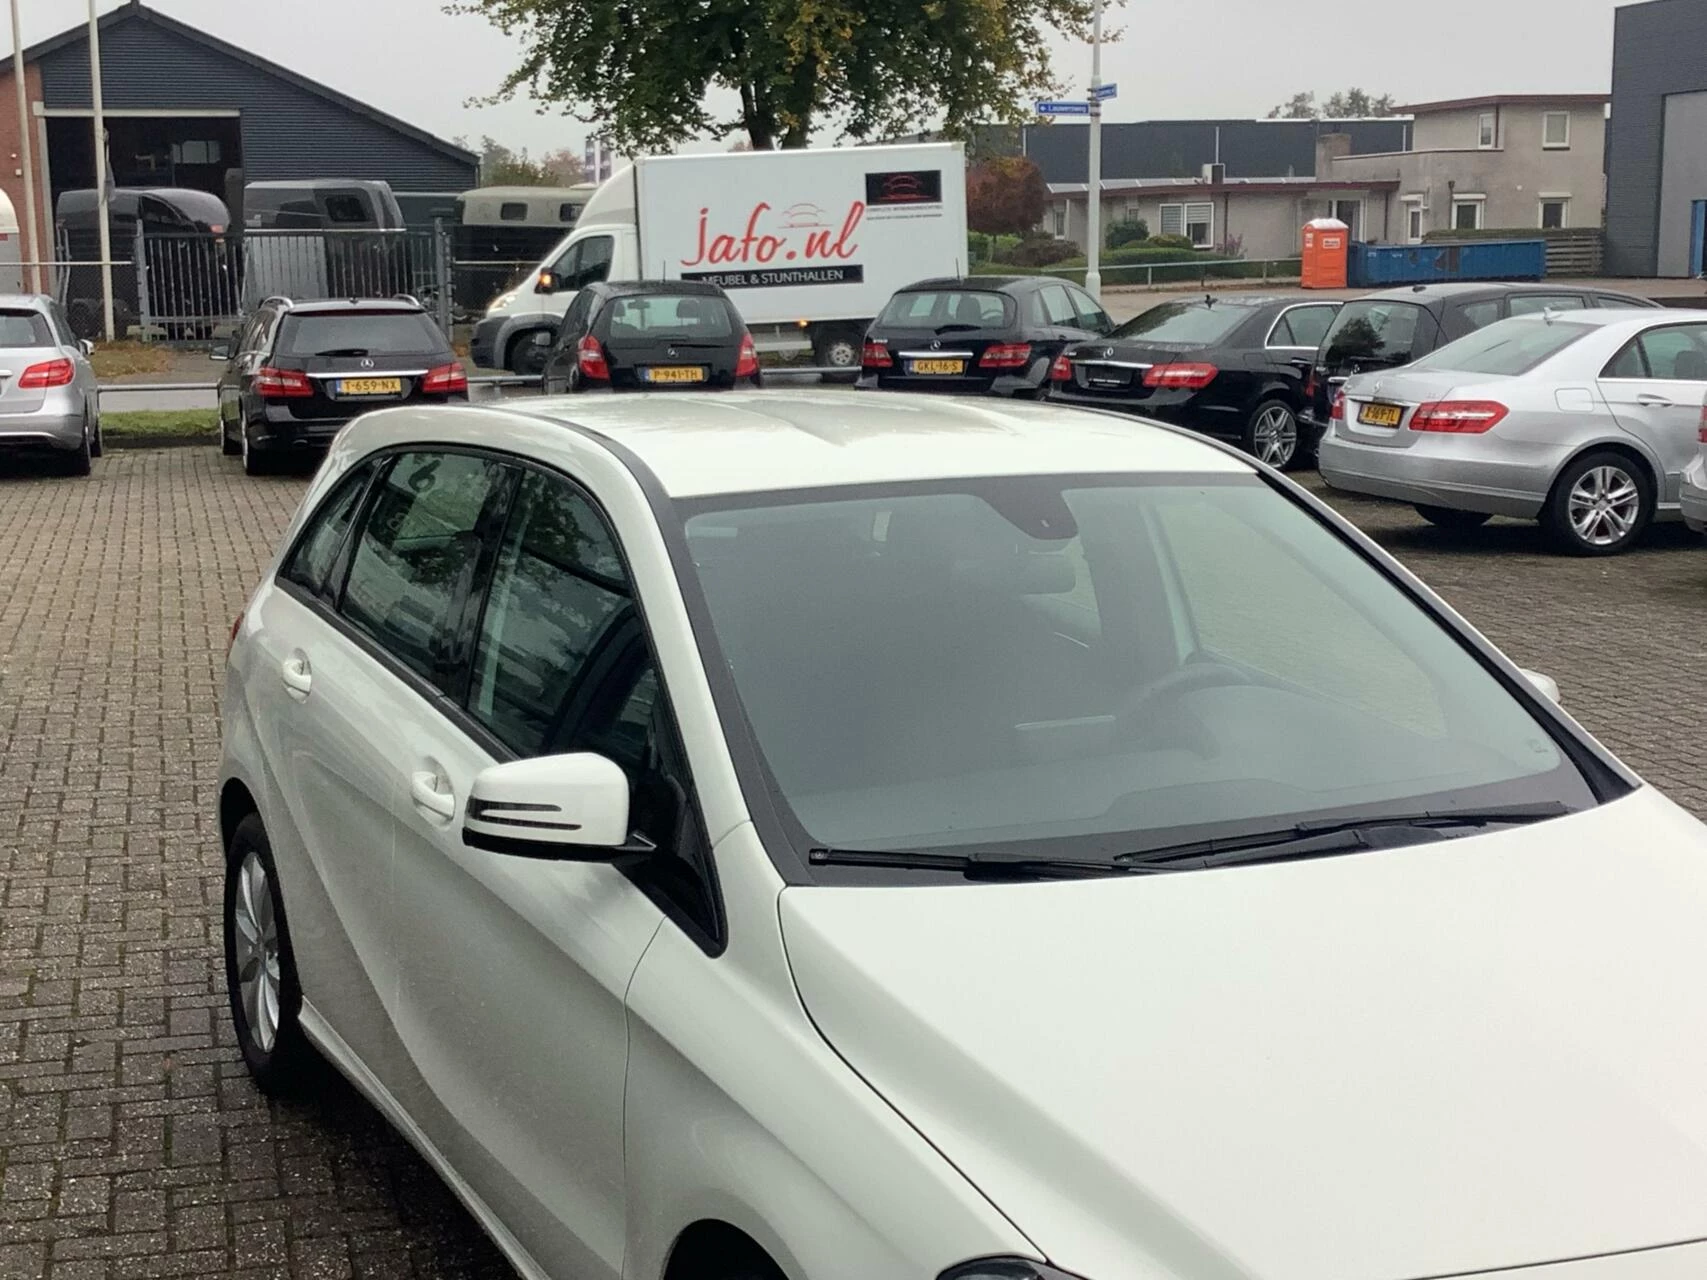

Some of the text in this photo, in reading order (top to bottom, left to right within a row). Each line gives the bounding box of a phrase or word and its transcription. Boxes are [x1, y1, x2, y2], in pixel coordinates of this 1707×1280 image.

[680, 201, 865, 266] jafo.nl
[750, 274, 760, 285] &
[763, 269, 844, 284] STUNTHALLEN
[343, 380, 397, 392] T-659-NX
